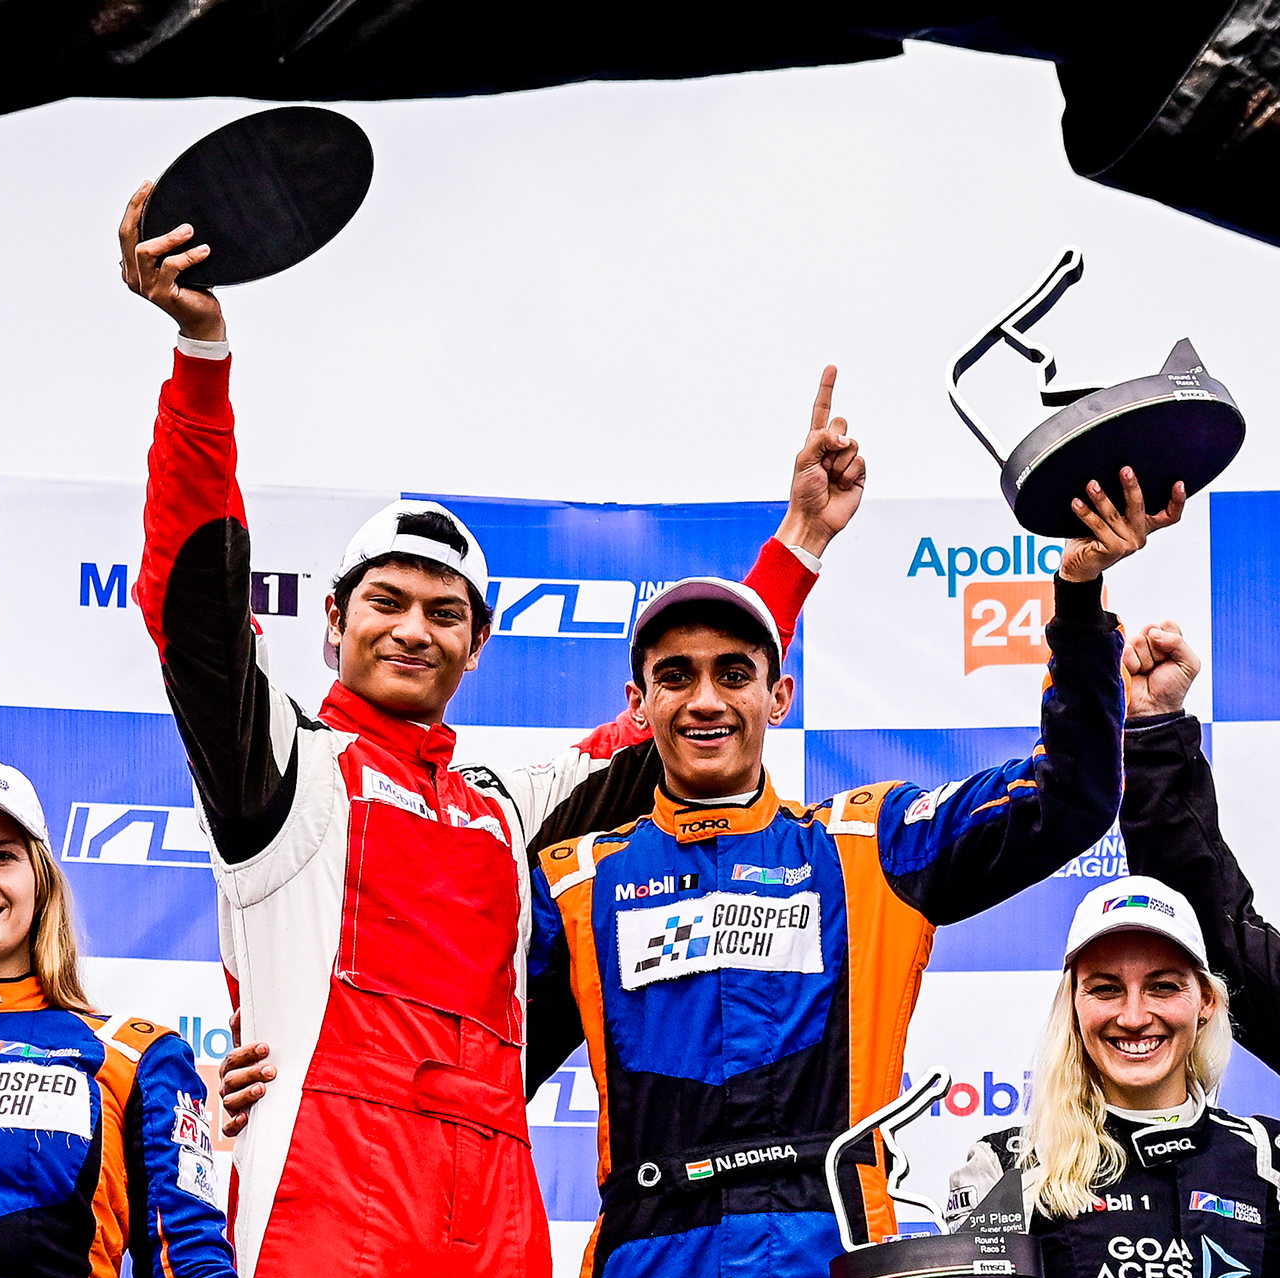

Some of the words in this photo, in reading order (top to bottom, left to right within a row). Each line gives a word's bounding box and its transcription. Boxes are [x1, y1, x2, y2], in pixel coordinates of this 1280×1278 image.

[907, 537, 1063, 598] Apollo
[678, 818, 732, 835] TORQ
[615, 876, 675, 902] Mobil
[712, 904, 810, 930] GODSPEED
[713, 930, 774, 957] KOCHI
[1144, 1137, 1196, 1157] TORQ
[715, 1145, 798, 1172] N.BOHRA
[1140, 1194, 1151, 1211] 1
[969, 1214, 986, 1228] 3rd
[990, 1212, 1022, 1225] Place
[974, 1236, 999, 1244] Round
[980, 1245, 1000, 1253] Race
[1107, 1236, 1194, 1262] GOA
[979, 1262, 1006, 1272] fmsci
